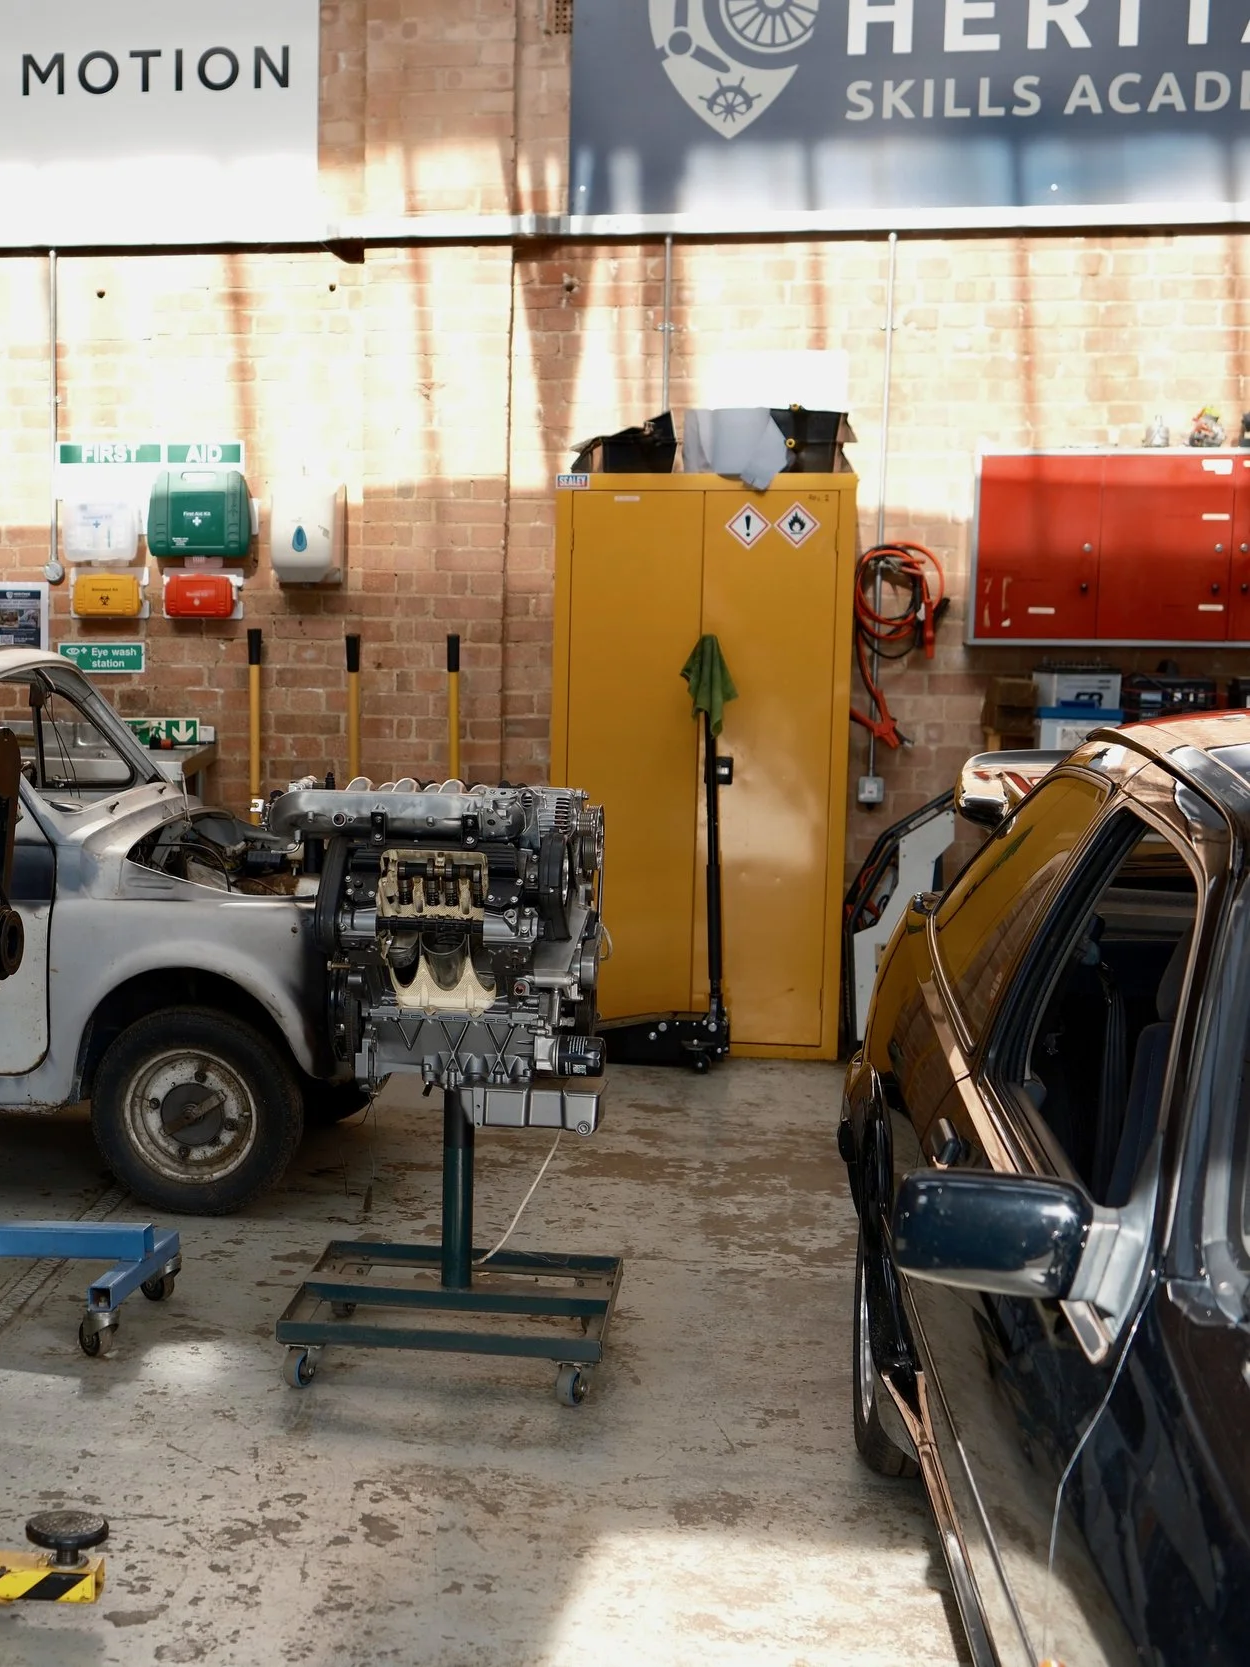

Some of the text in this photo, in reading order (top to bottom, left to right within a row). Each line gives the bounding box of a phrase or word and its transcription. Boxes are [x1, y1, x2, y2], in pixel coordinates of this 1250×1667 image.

[847, 0, 1250, 55] HERI
[22, 45, 290, 96] MOTION
[845, 75, 1041, 121] SKILLS
[81, 443, 223, 464] FIRST AID
[558, 475, 586, 486] SEALEY
[91, 647, 137, 658] Eye wash
[91, 659, 125, 668] station
